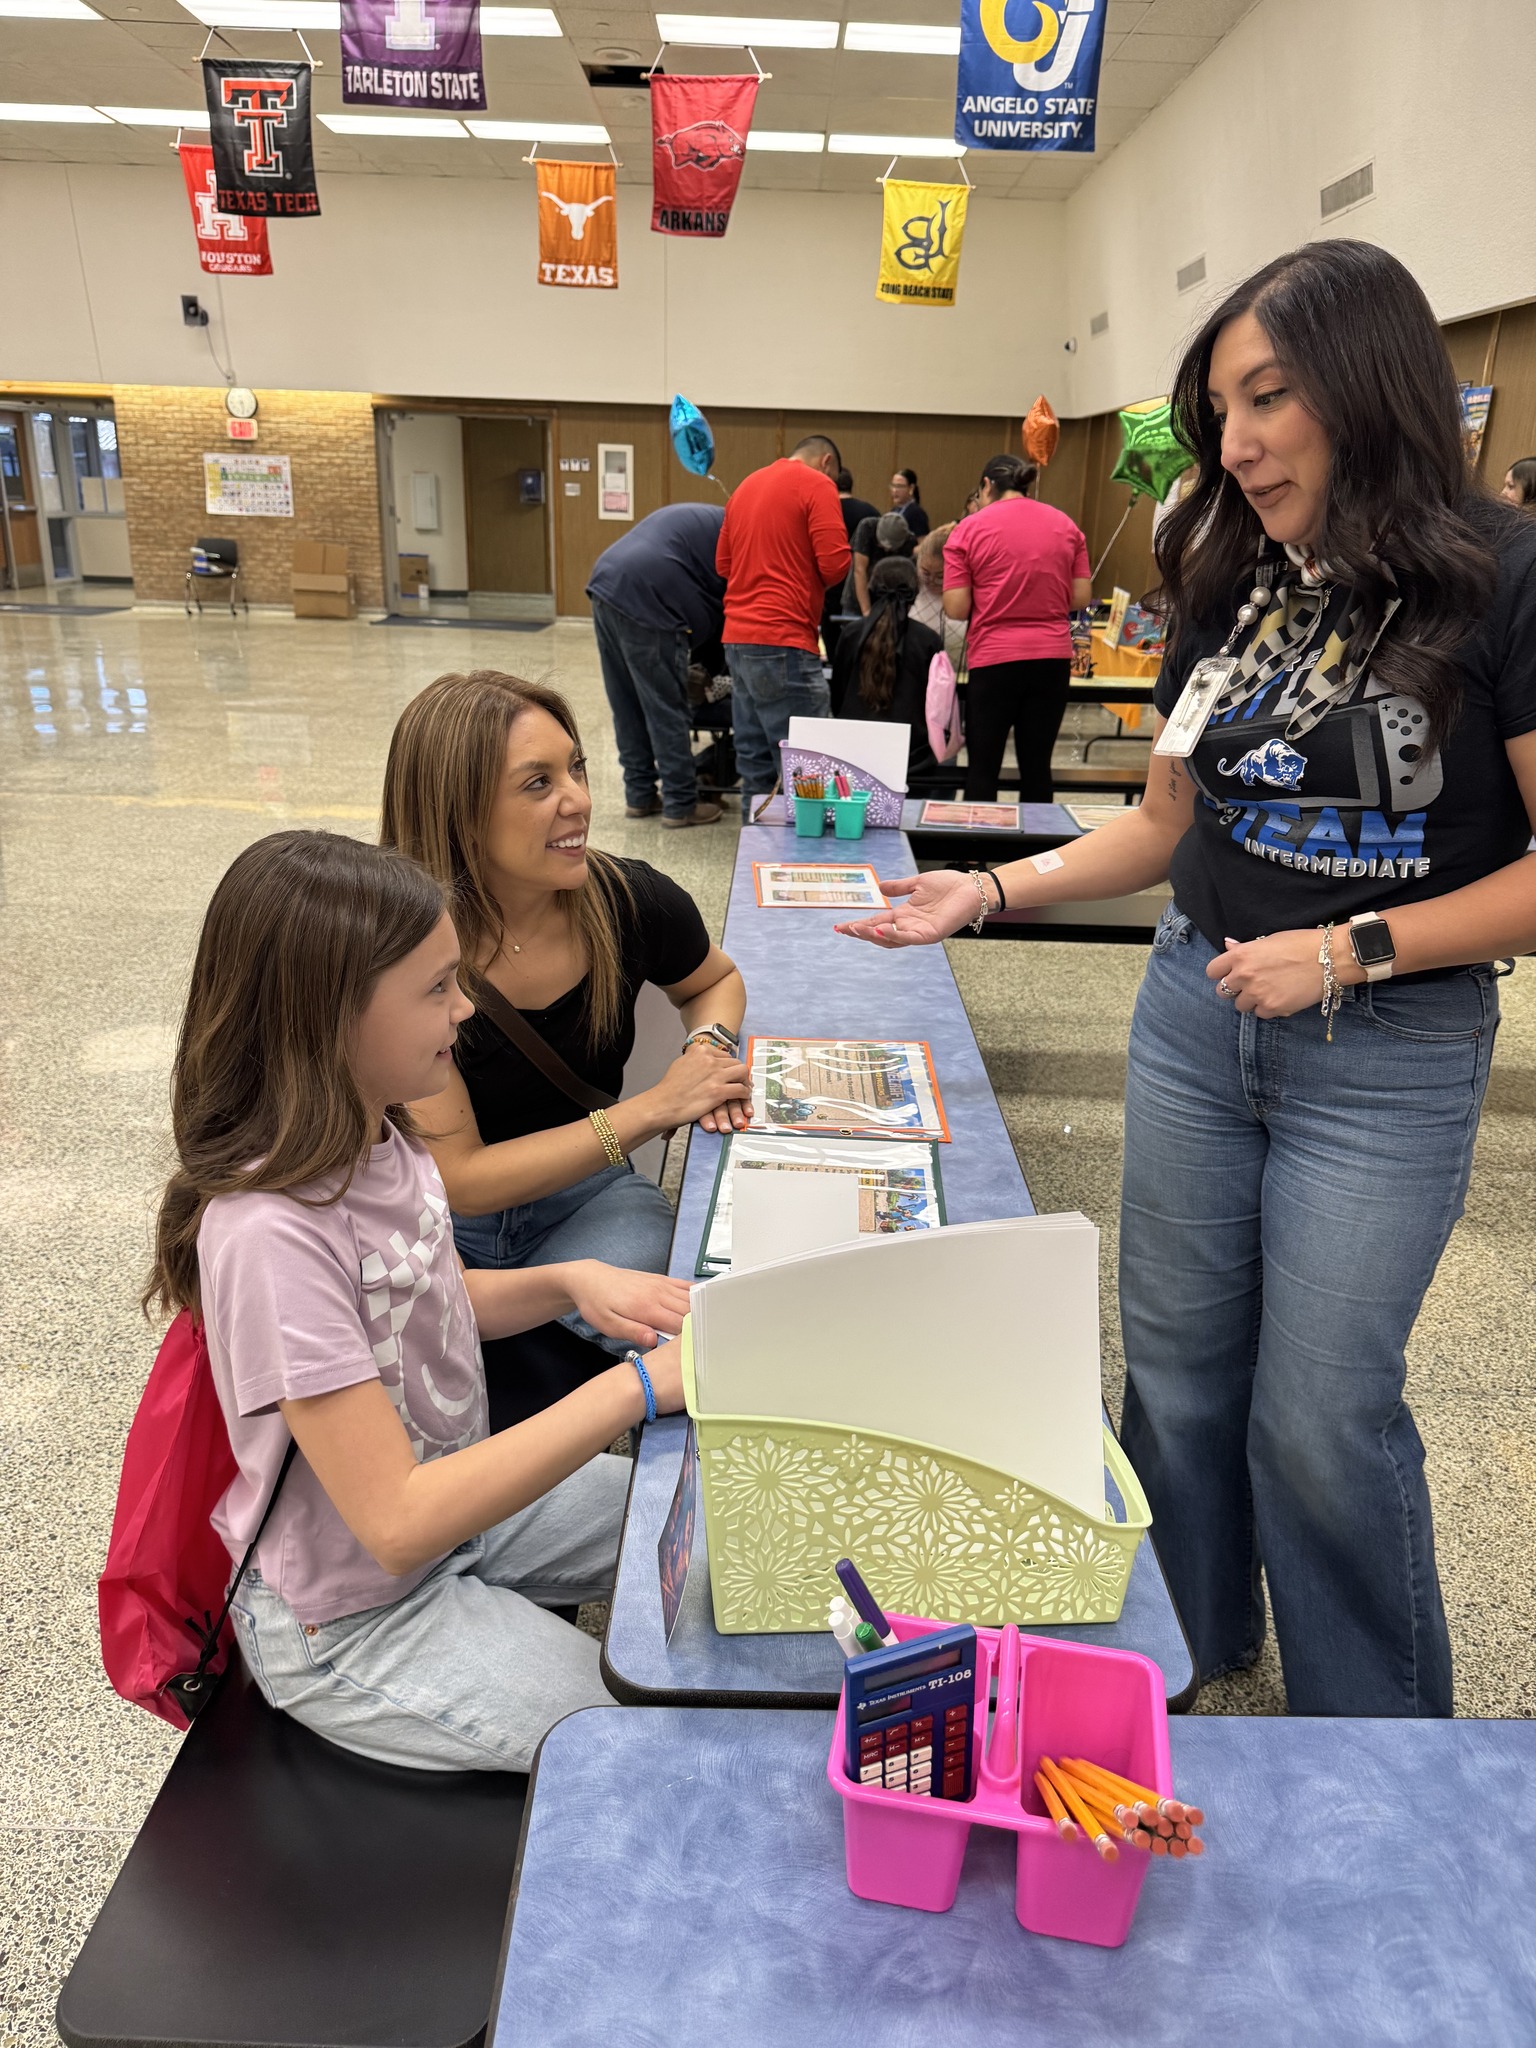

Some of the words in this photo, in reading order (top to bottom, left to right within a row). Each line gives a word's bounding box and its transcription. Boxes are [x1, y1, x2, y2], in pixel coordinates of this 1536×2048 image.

[345, 65, 428, 98] TARLETON
[430, 71, 480, 101] STATE
[962, 96, 1039, 115] ANGELO
[1044, 98, 1095, 116] STATE
[974, 120, 1083, 139] UNIVERSITY
[217, 190, 267, 212] TEXAS
[272, 192, 318, 213] TECH
[541, 262, 614, 287] TEXAS
[1224, 797, 1428, 864] TEAM
[1243, 836, 1431, 879] INTERMEDIATE
[928, 1669, 972, 1690] TI-108
[863, 1751, 879, 1760] MRC
